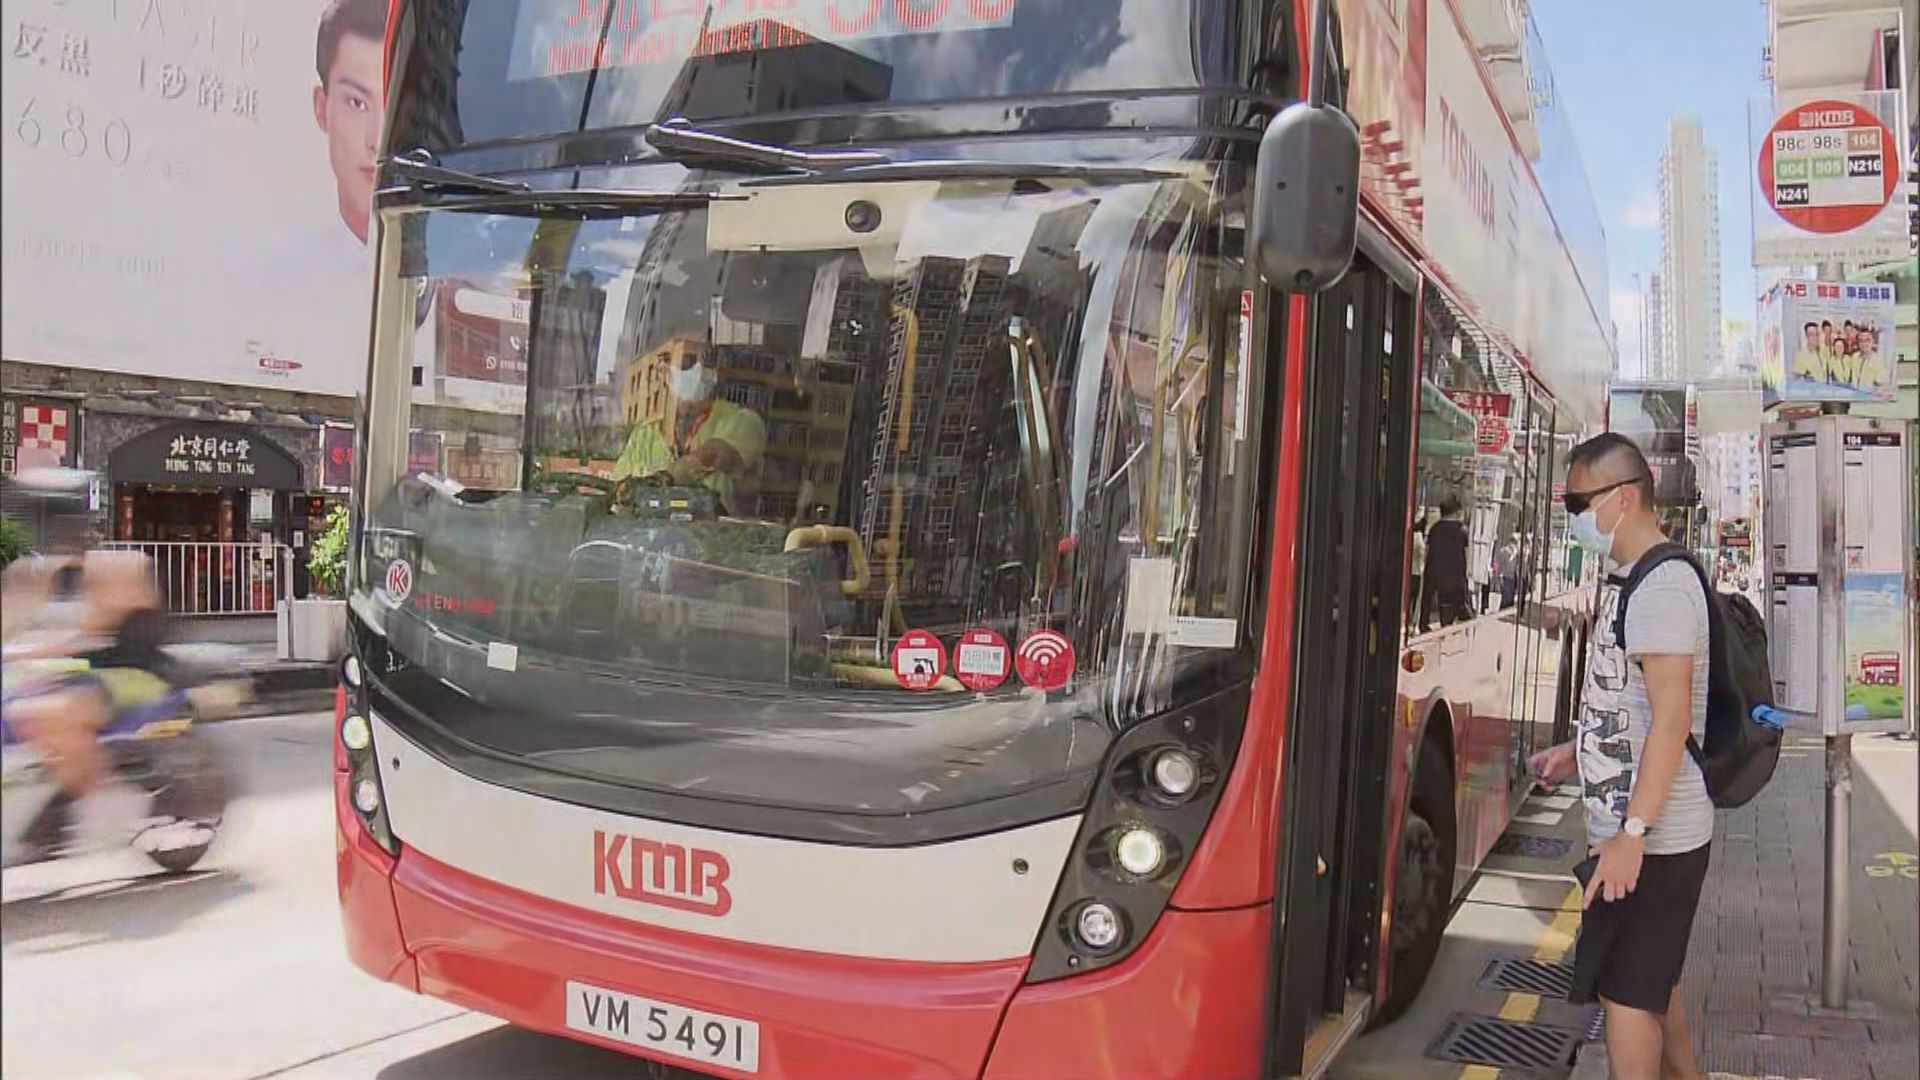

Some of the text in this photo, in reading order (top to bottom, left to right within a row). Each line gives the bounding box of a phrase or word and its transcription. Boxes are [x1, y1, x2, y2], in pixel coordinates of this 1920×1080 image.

[1815, 111, 1854, 126] KMB
[17, 98, 131, 167] 680
[1853, 134, 1877, 146] 104
[1440, 96, 1495, 240] TOSHIBA
[1848, 160, 1881, 172] N216
[1777, 188, 1808, 200] N241
[170, 434, 251, 459] 北京同仁堂
[194, 459, 213, 473] TONG
[217, 461, 232, 473] REN
[236, 462, 255, 475] TANG
[594, 830, 732, 917] KMB
[582, 991, 742, 1062] VM 5491
